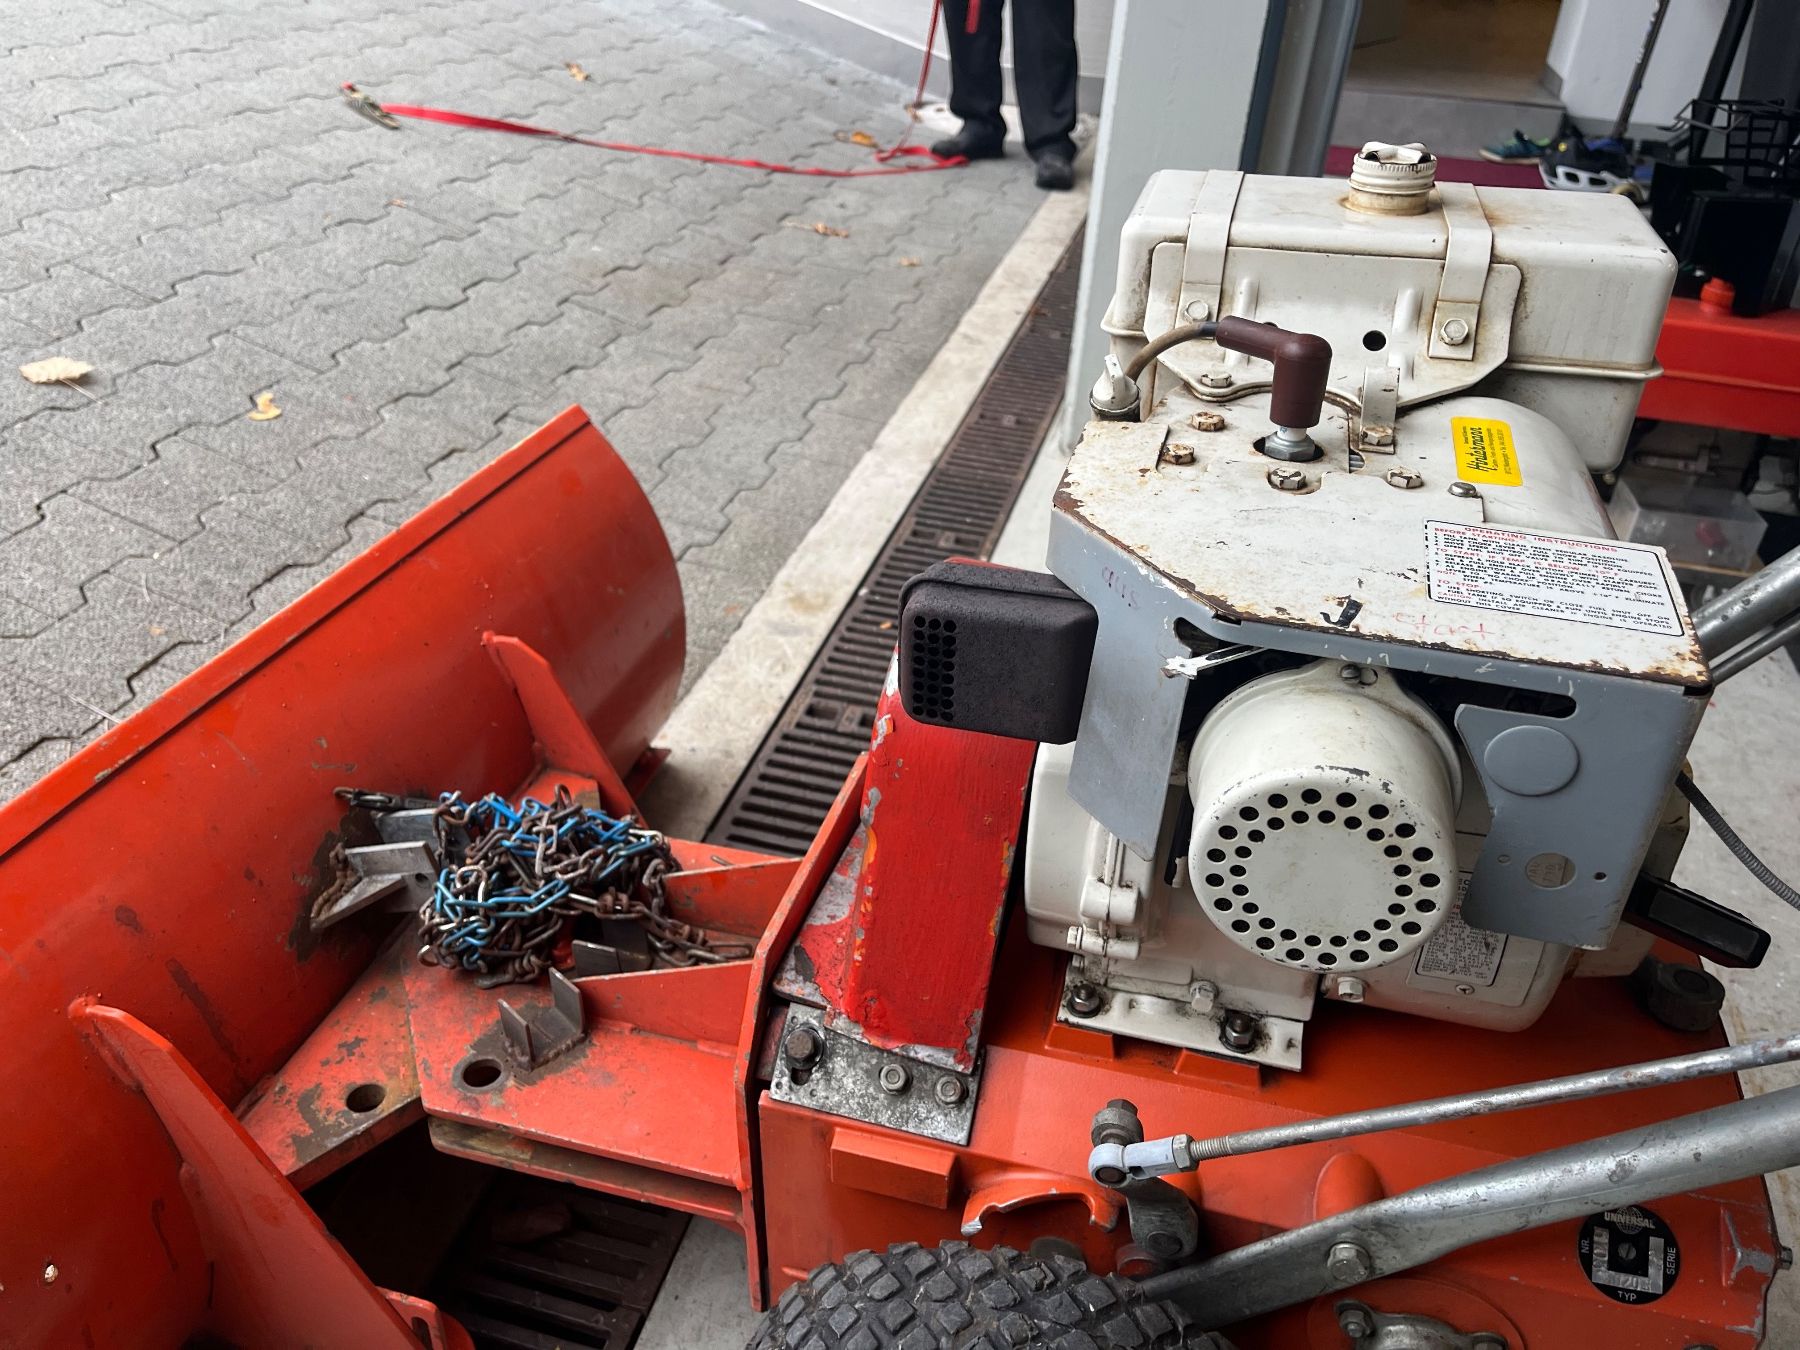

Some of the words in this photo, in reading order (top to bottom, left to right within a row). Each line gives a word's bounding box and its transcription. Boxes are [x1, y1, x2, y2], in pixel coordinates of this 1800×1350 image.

[1604, 1211, 1656, 1229] UNIVERSAL
[1666, 1247, 1676, 1275] SERIE
[1617, 1291, 1637, 1301] TYP
